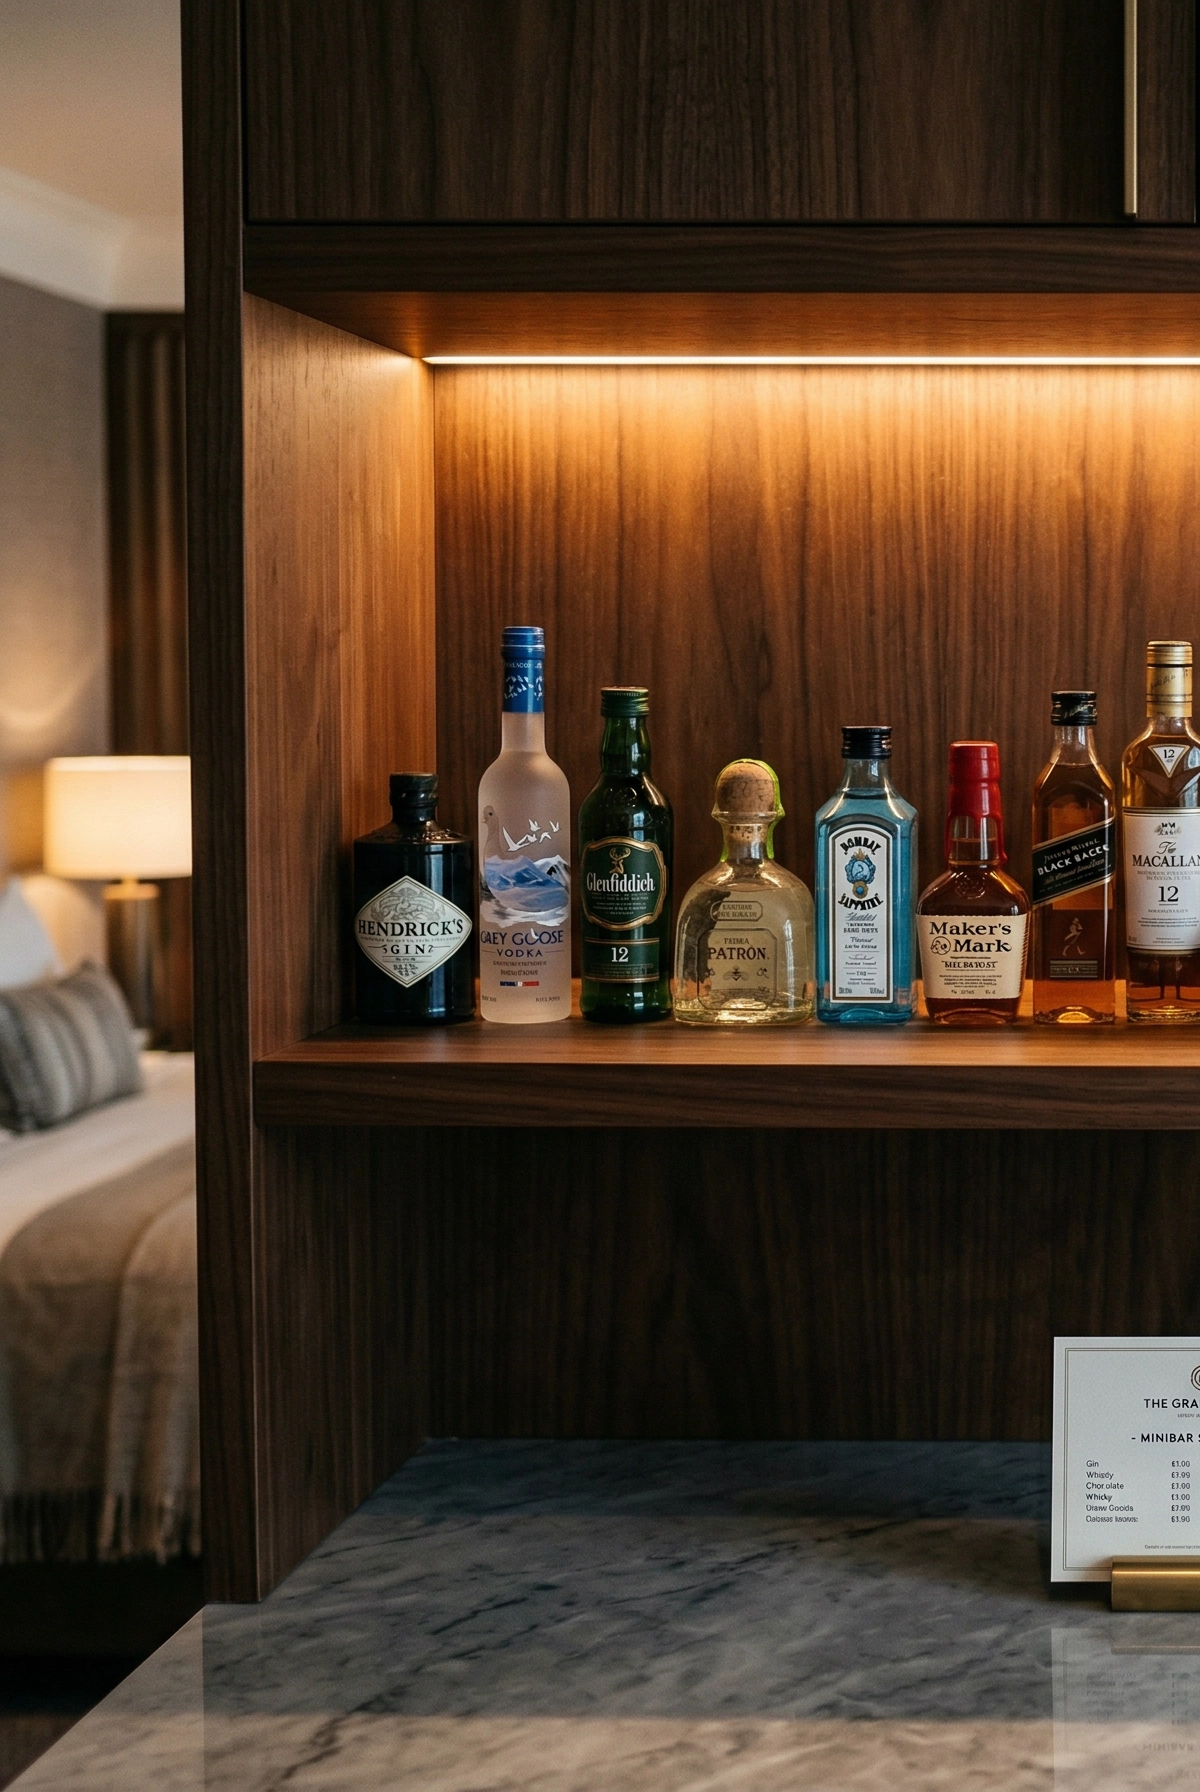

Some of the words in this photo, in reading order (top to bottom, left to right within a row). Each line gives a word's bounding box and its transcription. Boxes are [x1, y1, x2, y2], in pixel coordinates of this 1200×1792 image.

[1163, 749, 1175, 759] 12
[586, 872, 656, 892] Glenfiddich
[1158, 886, 1179, 902] 12
[358, 918, 464, 937] HENDRICK'S
[929, 922, 1012, 935] Maker's
[511, 930, 564, 945] GOOSE
[953, 939, 1012, 952] Mark
[497, 949, 543, 957] VODKA
[611, 946, 629, 962] 12
[1143, 1398, 1168, 1409] THE
[1140, 1433, 1194, 1443] MINIBAR
